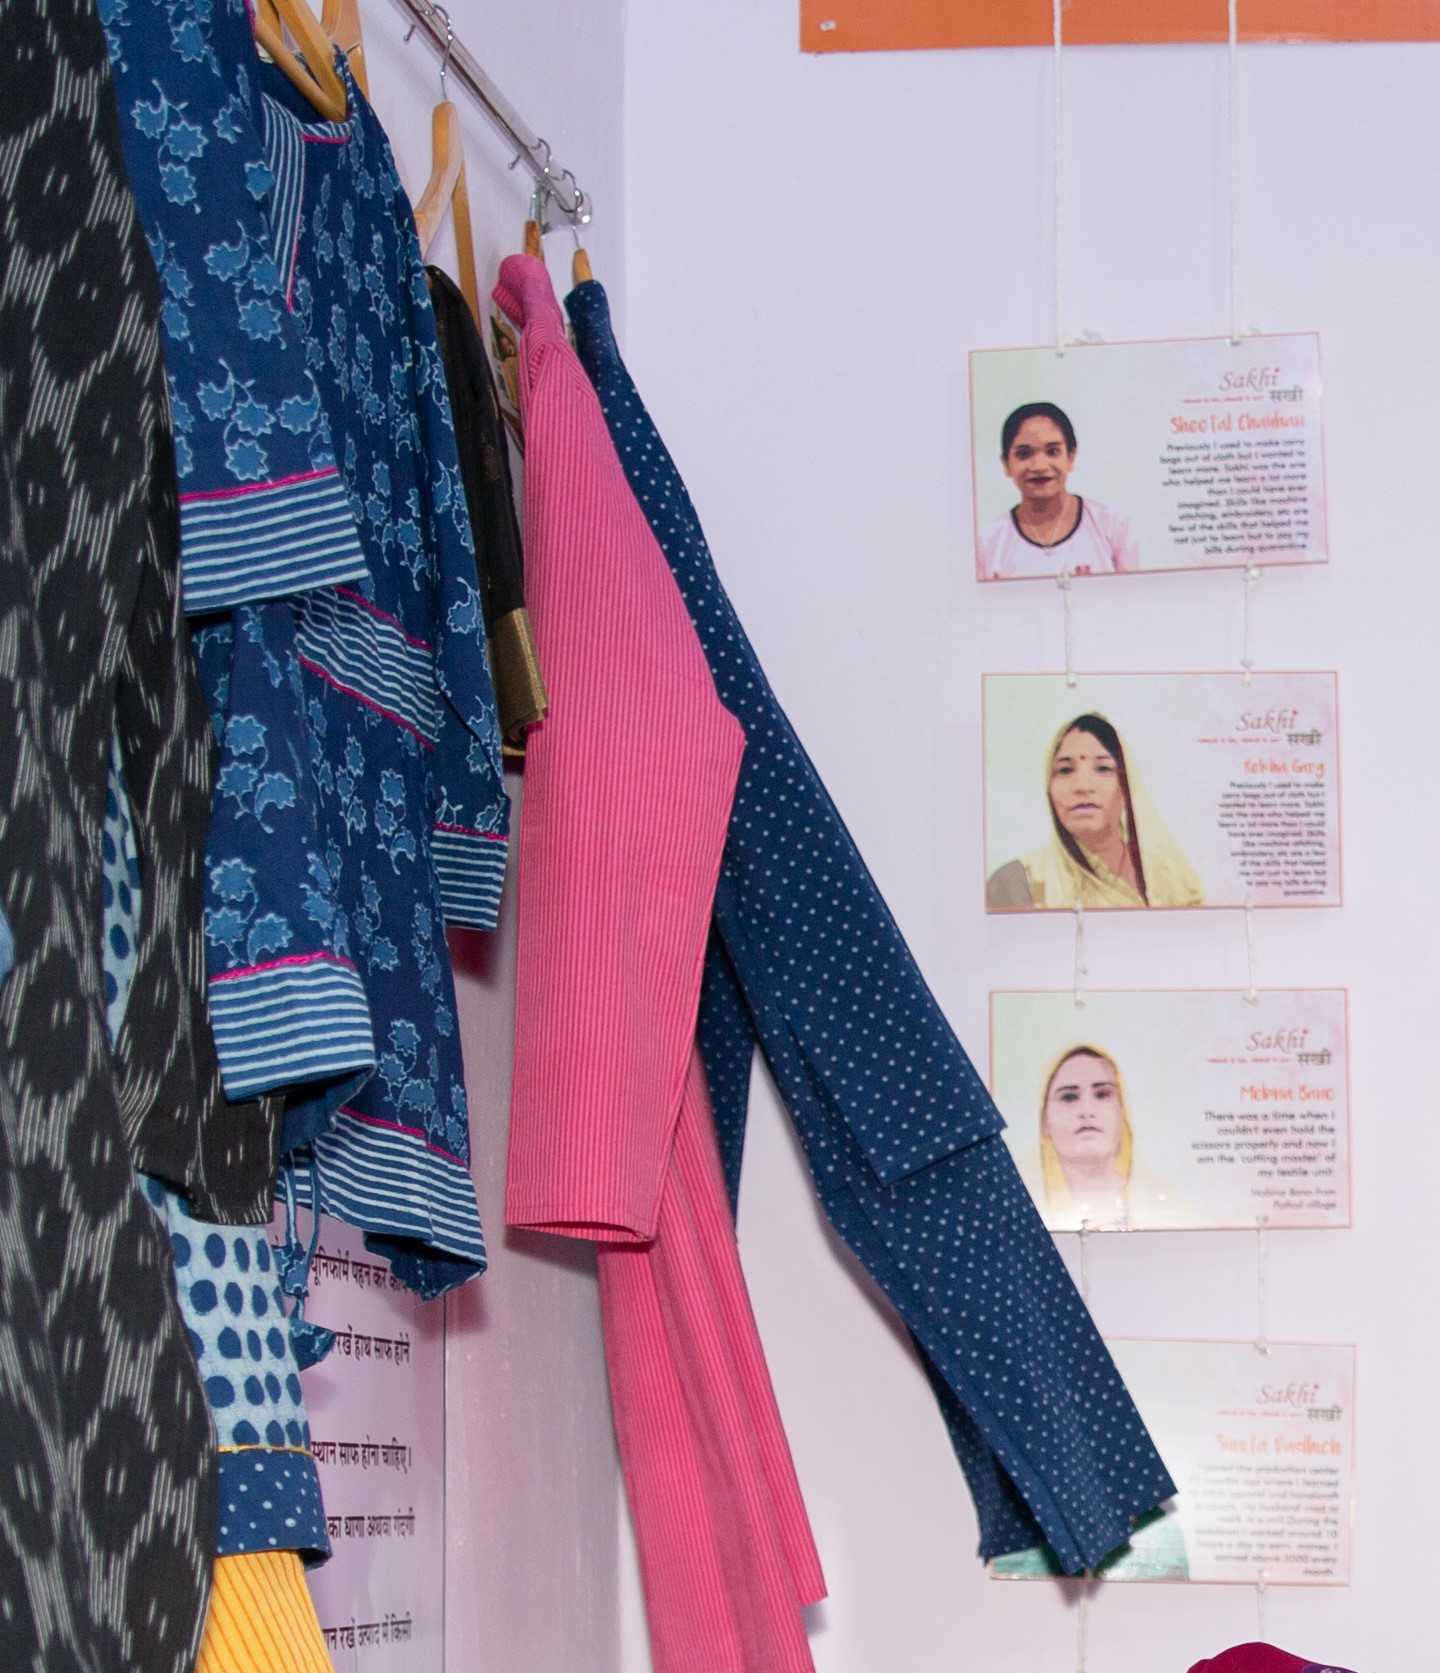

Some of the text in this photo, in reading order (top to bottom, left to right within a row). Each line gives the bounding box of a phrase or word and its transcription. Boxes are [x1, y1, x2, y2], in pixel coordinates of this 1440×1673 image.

[1219, 366, 1280, 390] Sakhi
[1236, 710, 1298, 733] Sakhi
[1245, 1029, 1309, 1054] Sakhi
[373, 1266, 387, 1289] कर
[373, 1337, 393, 1361] साफ
[1256, 1382, 1320, 1407] Sakhi
[339, 1443, 359, 1470] साफ
[361, 1435, 379, 1470] होना
